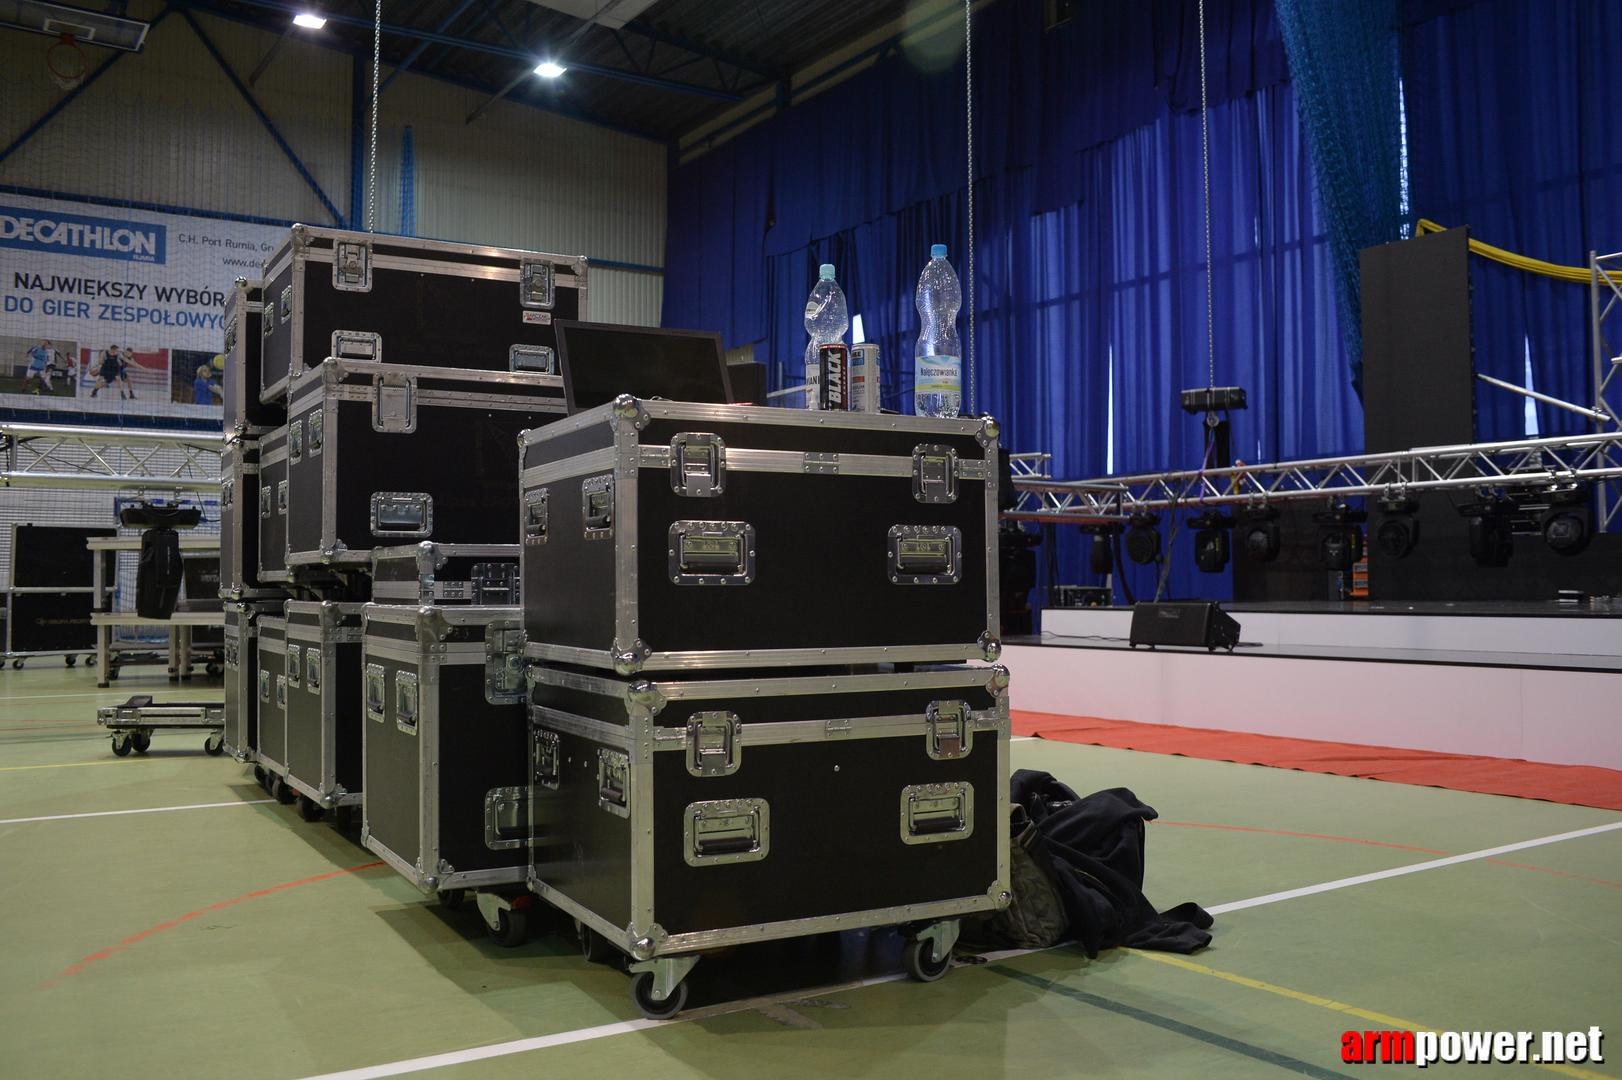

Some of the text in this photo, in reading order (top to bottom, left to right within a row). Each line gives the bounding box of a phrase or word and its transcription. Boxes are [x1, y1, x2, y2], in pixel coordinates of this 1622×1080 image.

[0, 215, 156, 255] DECATHLON
[178, 233, 199, 245] C.H.
[202, 235, 221, 247] Port
[225, 239, 258, 252] Rumia,
[4, 295, 34, 314] DO
[43, 298, 91, 319] GIER
[14, 271, 225, 308] NAJWIĘKSZY WYBÓR
[828, 351, 842, 403] BLACK
